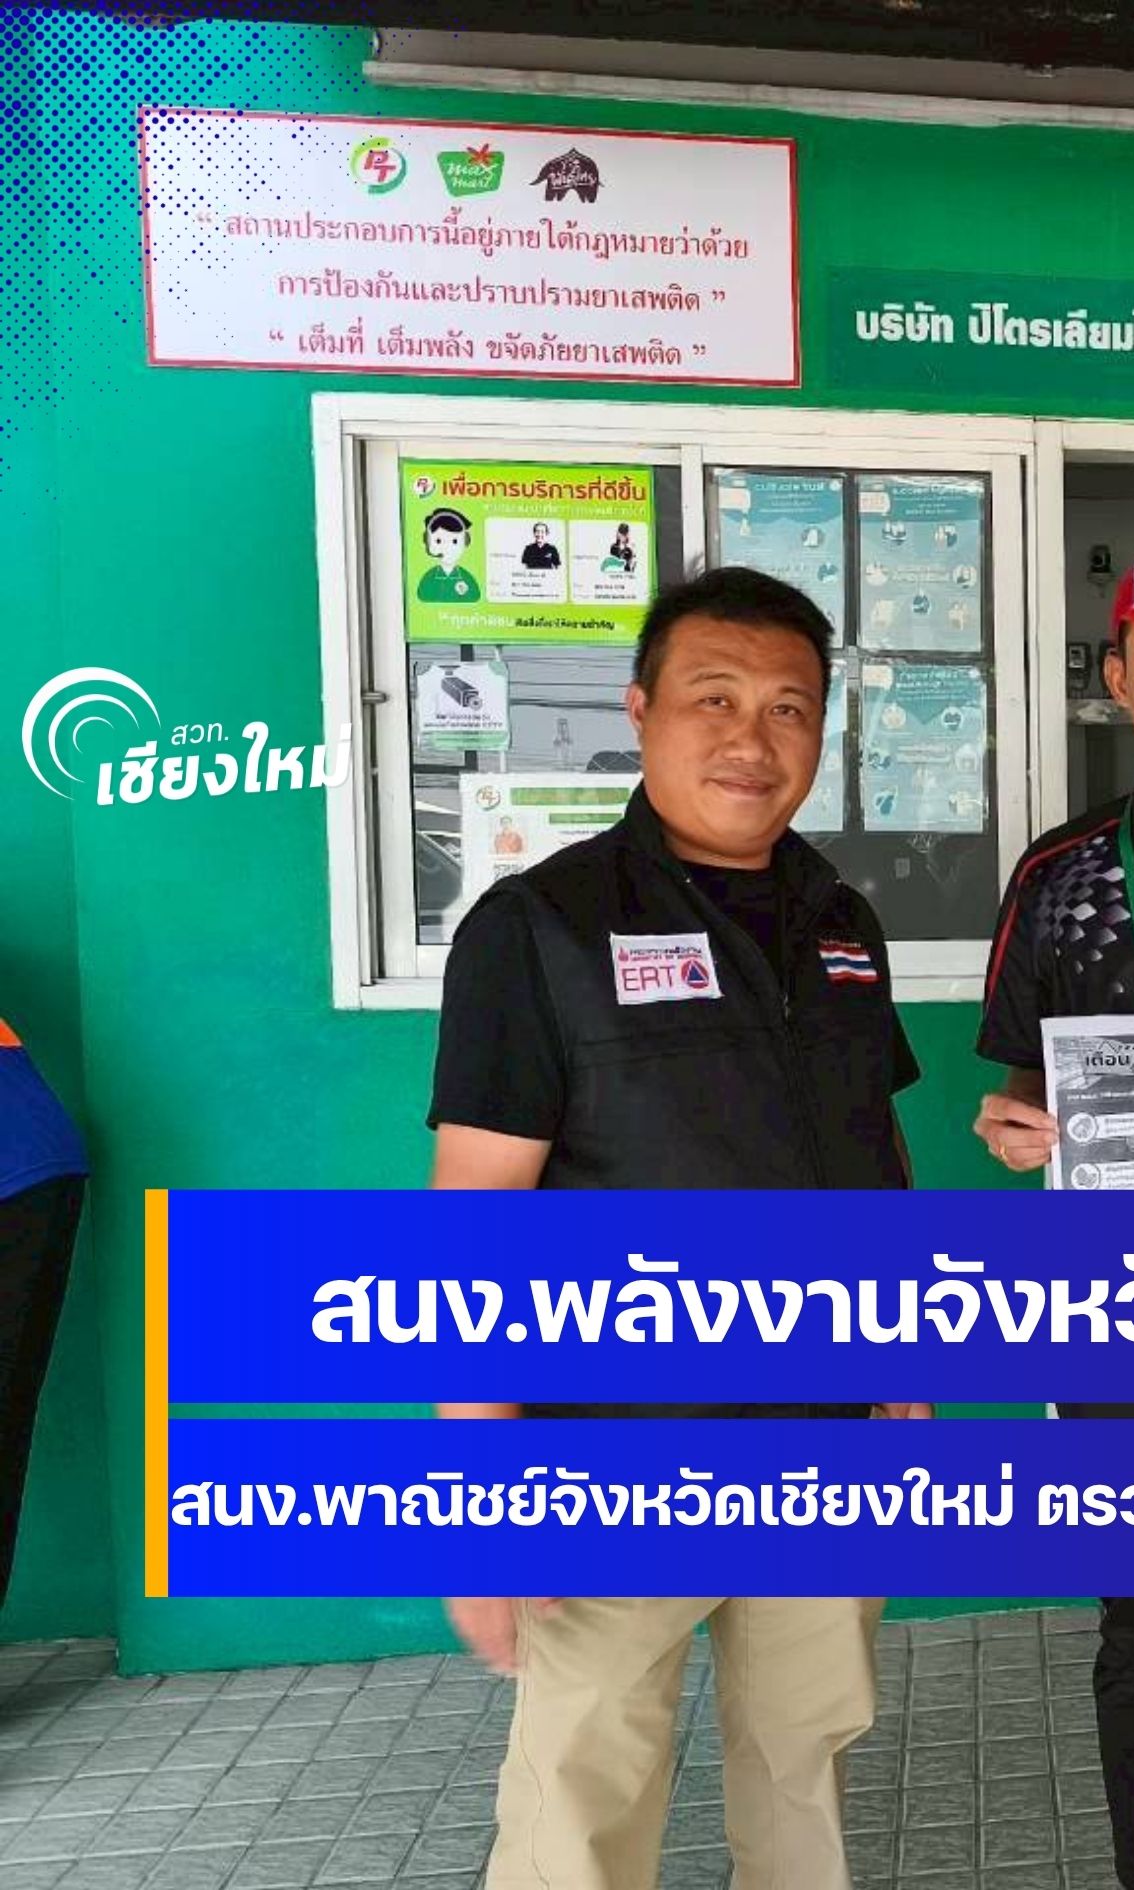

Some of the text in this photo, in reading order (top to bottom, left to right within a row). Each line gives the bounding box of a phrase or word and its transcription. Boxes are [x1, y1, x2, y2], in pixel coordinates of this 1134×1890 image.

[855, 301, 954, 343] บริษัท
[442, 472, 646, 501] เพื่อการบริการที่ดีขึ้น
[622, 966, 676, 991] ERT
